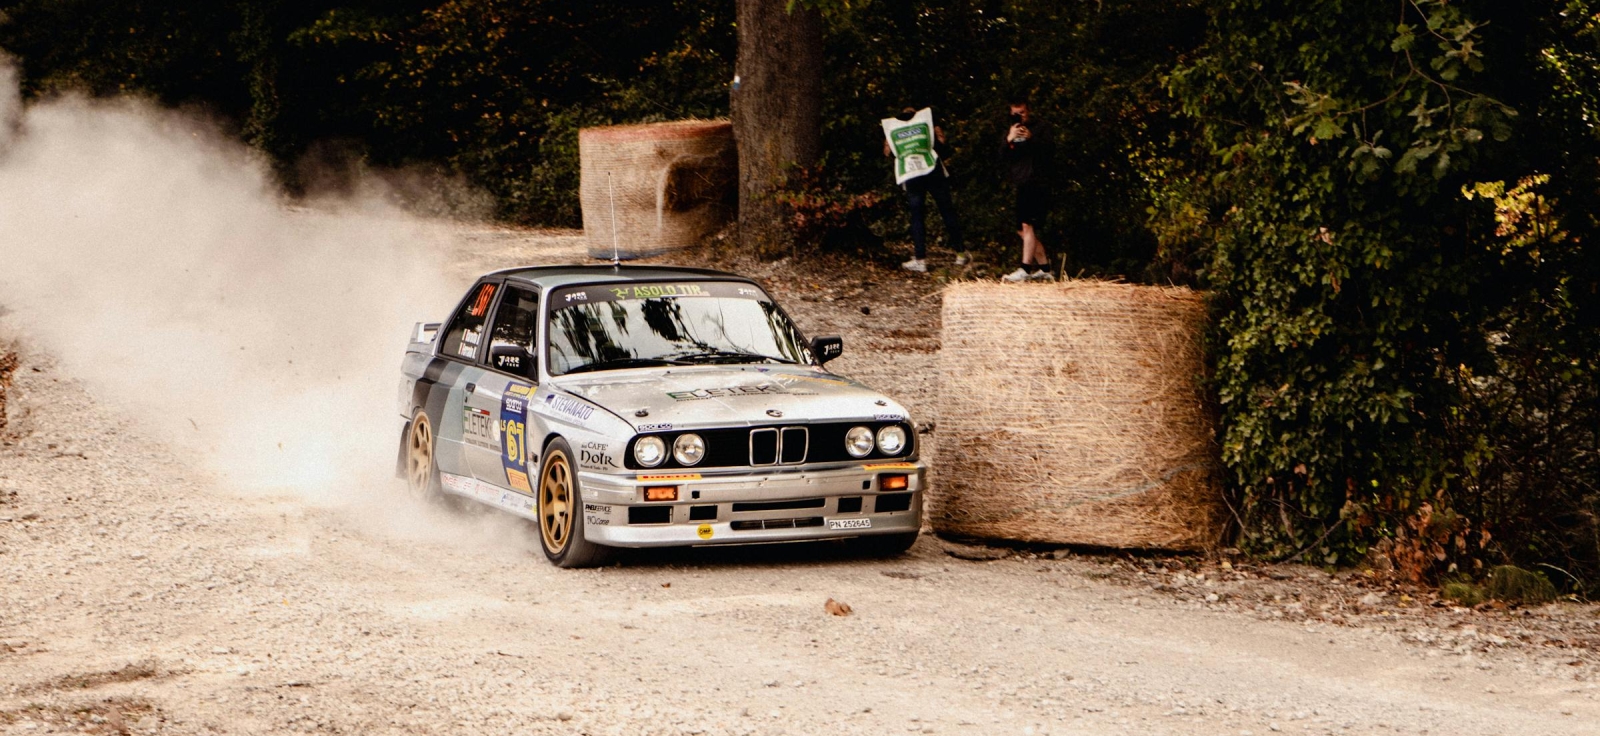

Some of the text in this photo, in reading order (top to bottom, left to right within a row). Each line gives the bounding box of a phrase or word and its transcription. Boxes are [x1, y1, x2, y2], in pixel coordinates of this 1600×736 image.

[633, 285, 676, 297] ASOLO
[677, 284, 701, 295] TIR
[551, 396, 594, 420] STEVANATO
[464, 409, 492, 439] ELETEK
